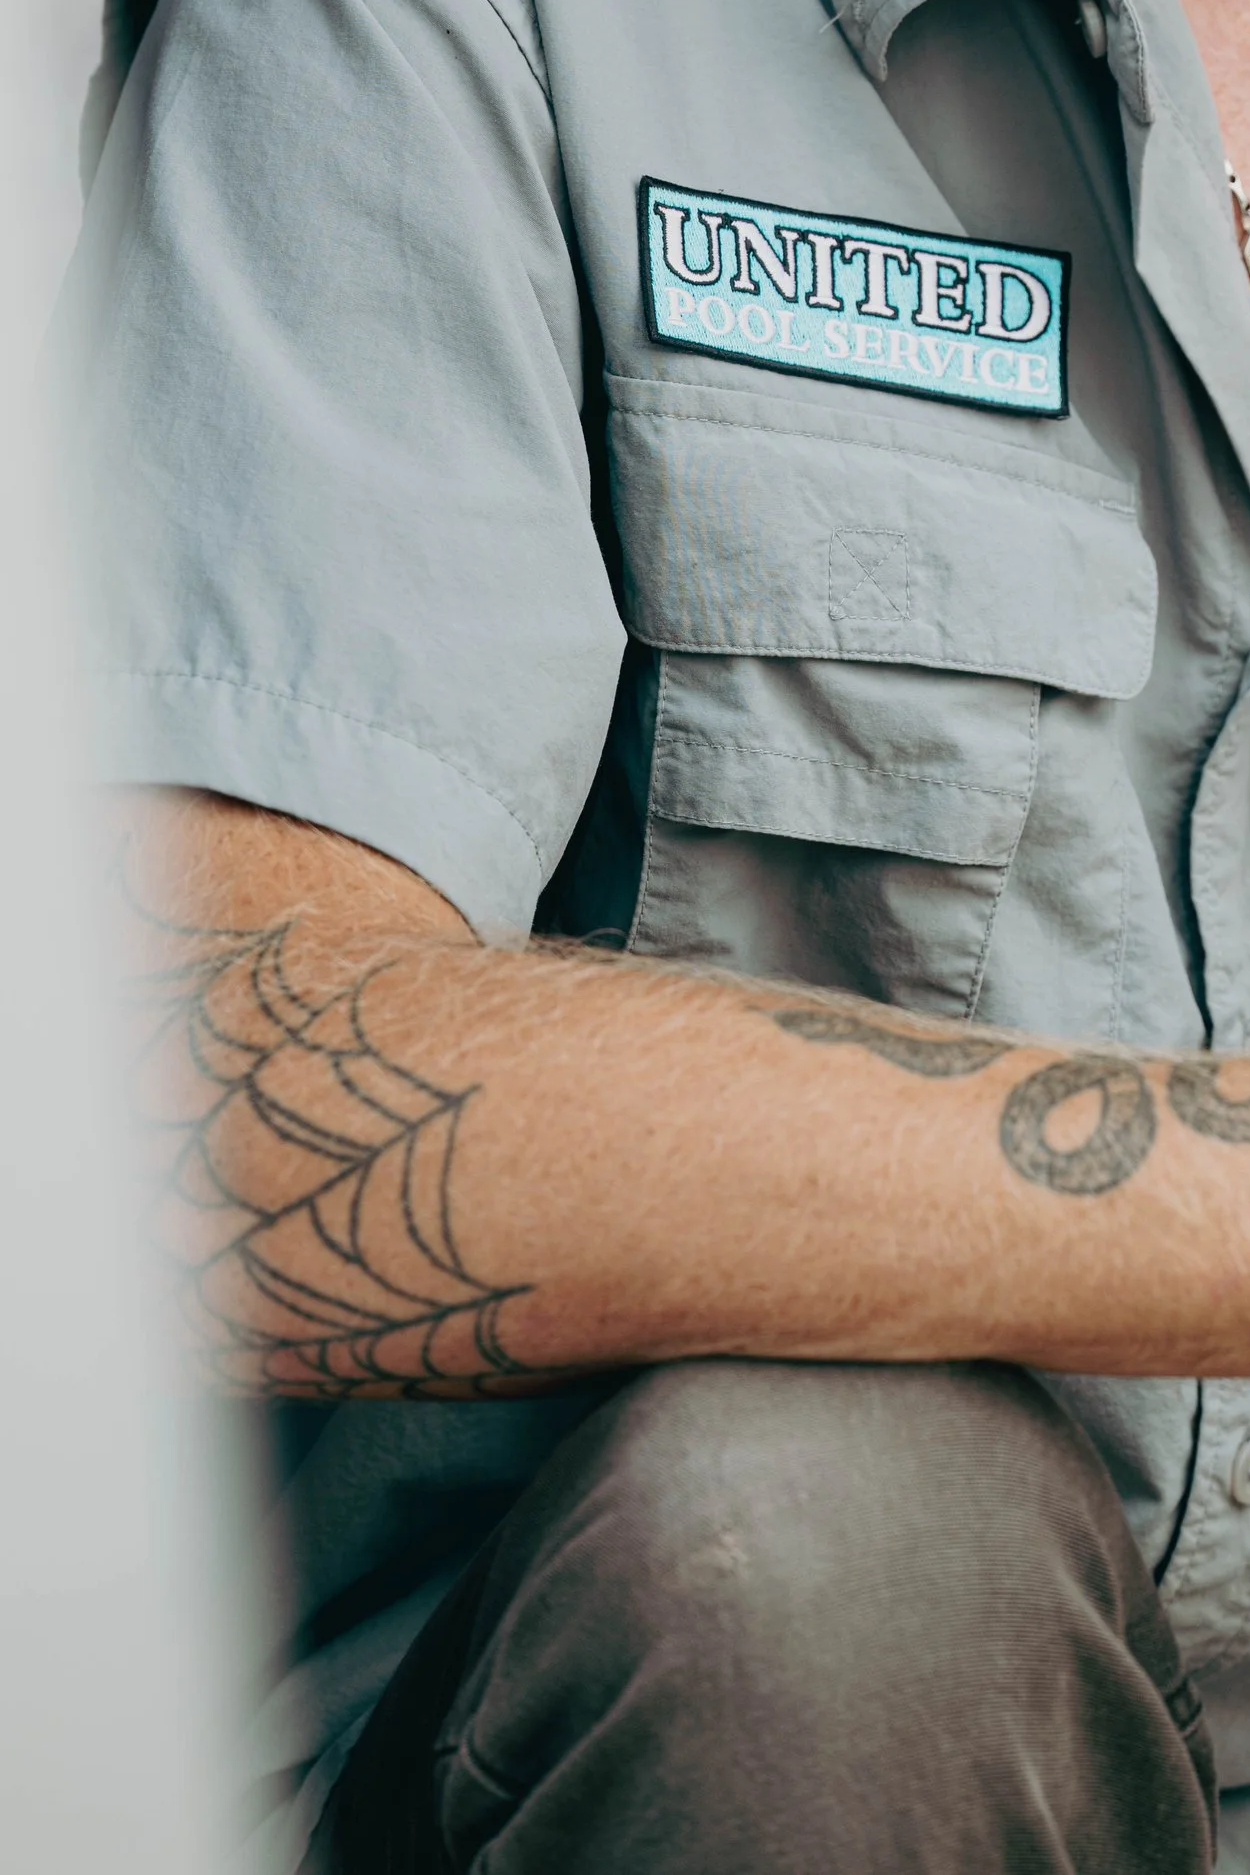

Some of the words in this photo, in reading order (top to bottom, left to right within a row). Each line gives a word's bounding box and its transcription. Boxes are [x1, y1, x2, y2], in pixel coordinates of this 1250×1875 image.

[654, 202, 1053, 343] UNITED
[665, 286, 809, 351] POOL
[823, 318, 1049, 394] SERVICE
